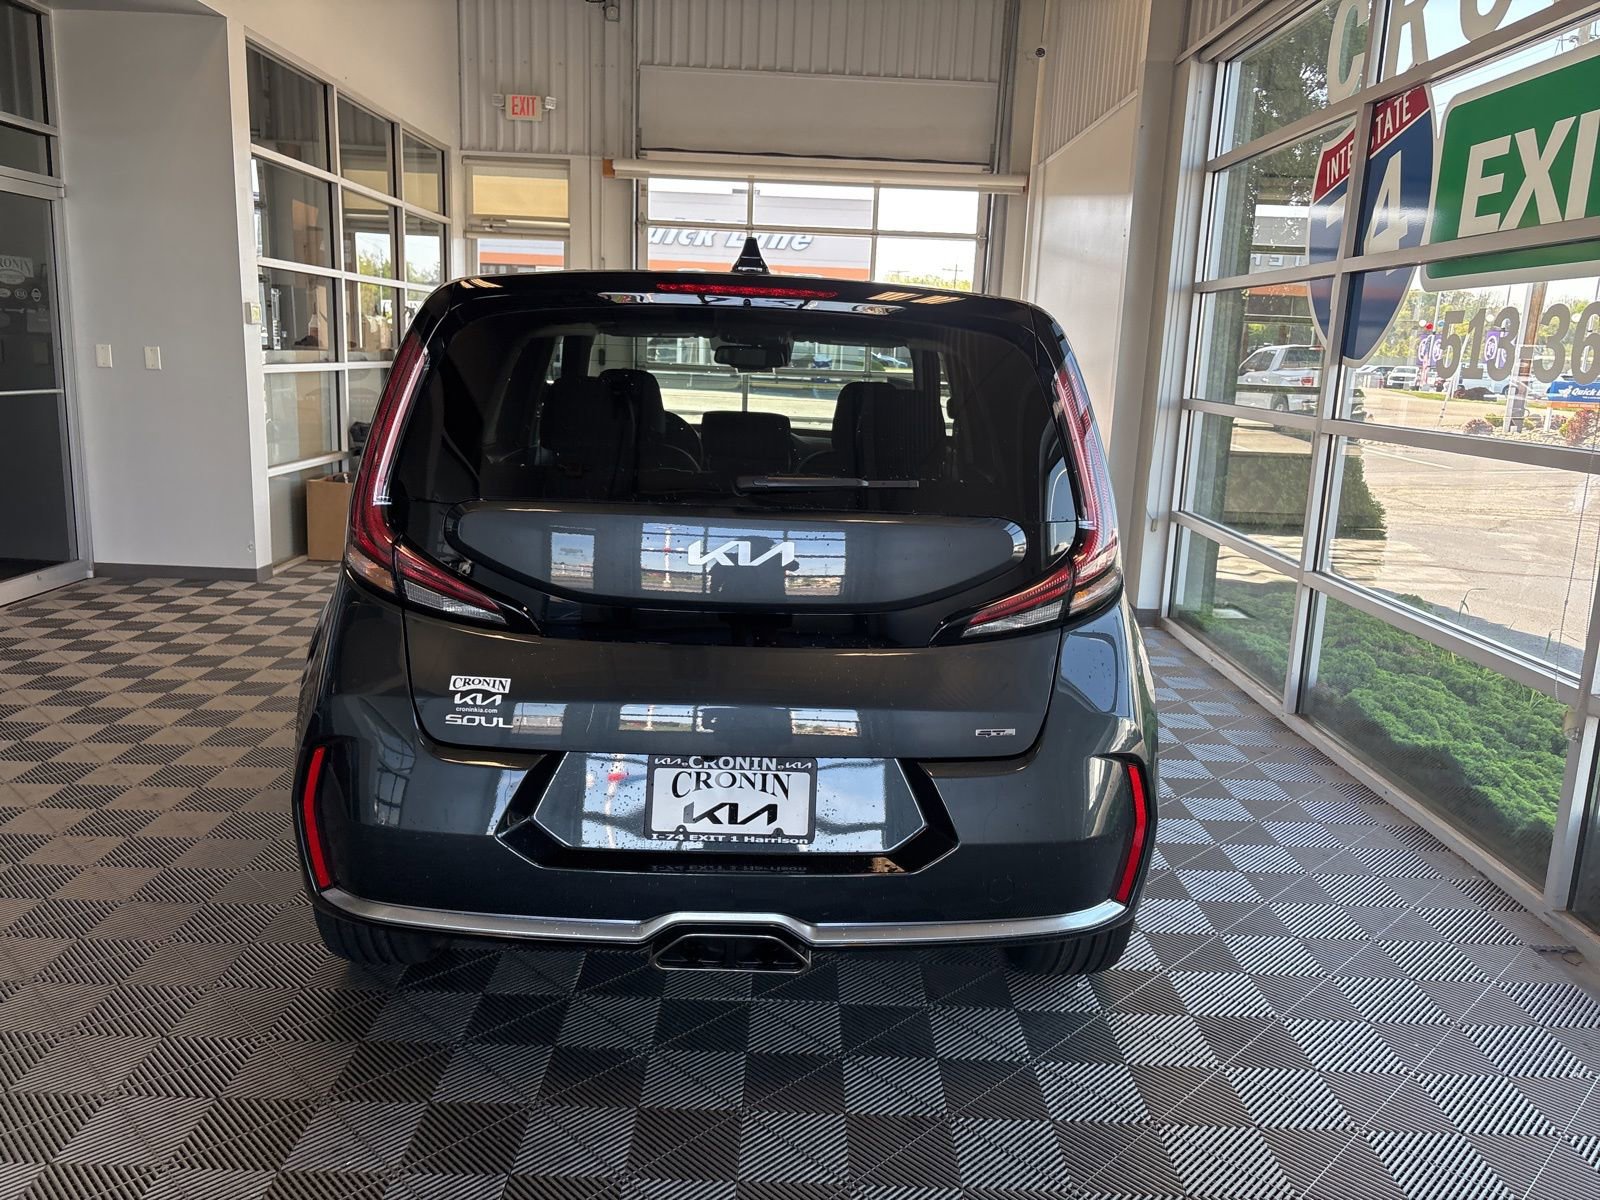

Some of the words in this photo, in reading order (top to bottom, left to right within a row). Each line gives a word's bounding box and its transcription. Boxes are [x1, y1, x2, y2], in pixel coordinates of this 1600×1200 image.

[511, 95, 536, 116] EXIT
[688, 540, 795, 567] KIA
[453, 677, 508, 692] CRONIN
[454, 692, 502, 706] KIA
[445, 714, 514, 728] SOUL
[688, 755, 777, 771] CRONIN
[671, 771, 792, 800] CRONIN
[683, 801, 778, 826] KIA
[651, 833, 685, 841] I-74
[689, 834, 726, 842] EXIT
[744, 836, 808, 845] Harrison
